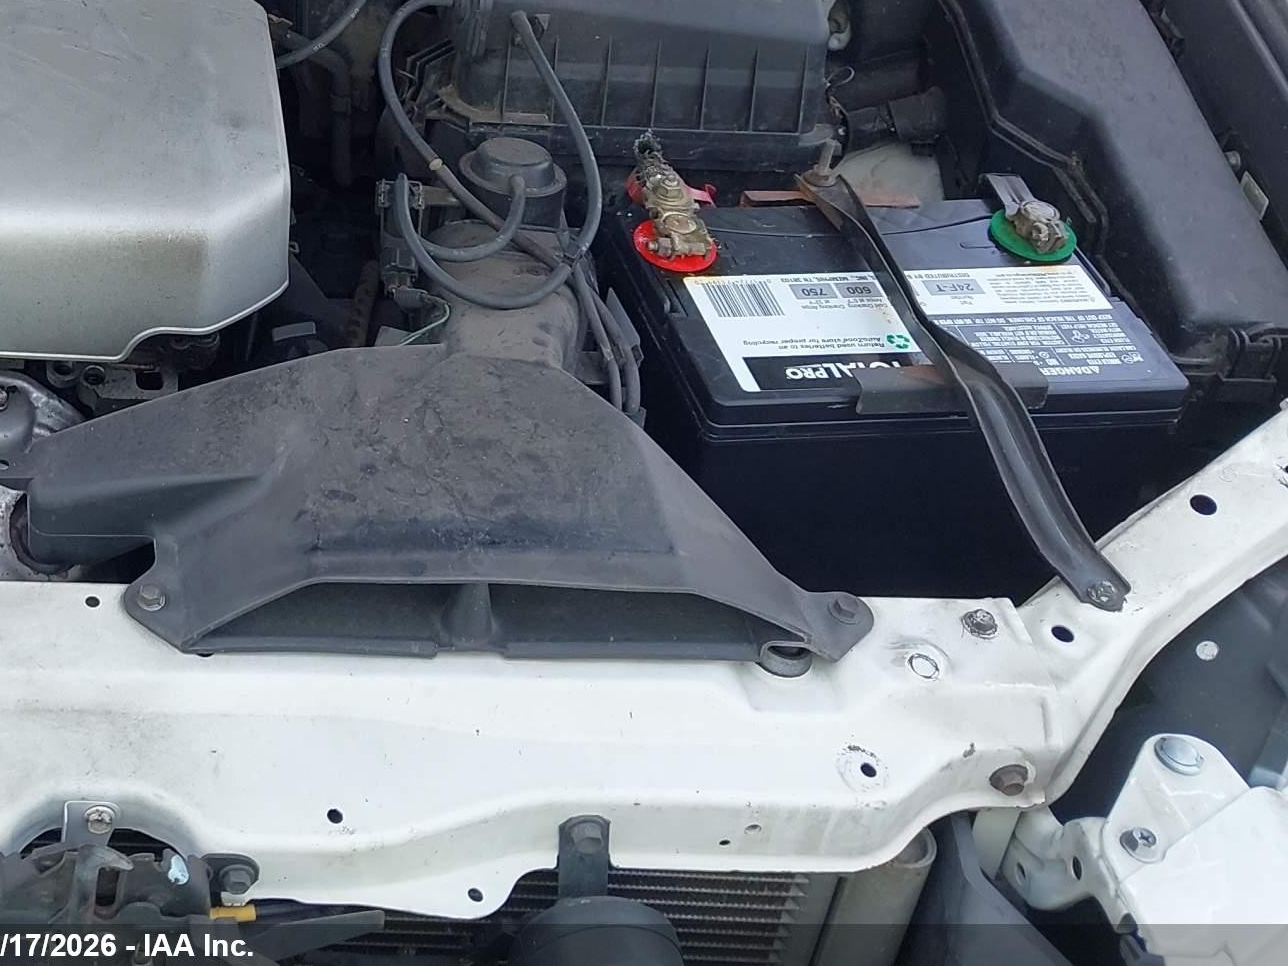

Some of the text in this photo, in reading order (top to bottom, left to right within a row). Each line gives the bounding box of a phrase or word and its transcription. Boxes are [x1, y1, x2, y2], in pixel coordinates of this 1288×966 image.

[846, 286, 872, 295] 600
[935, 282, 973, 292] 24F-T
[801, 288, 827, 296] 750
[1039, 366, 1092, 376] DANGER
